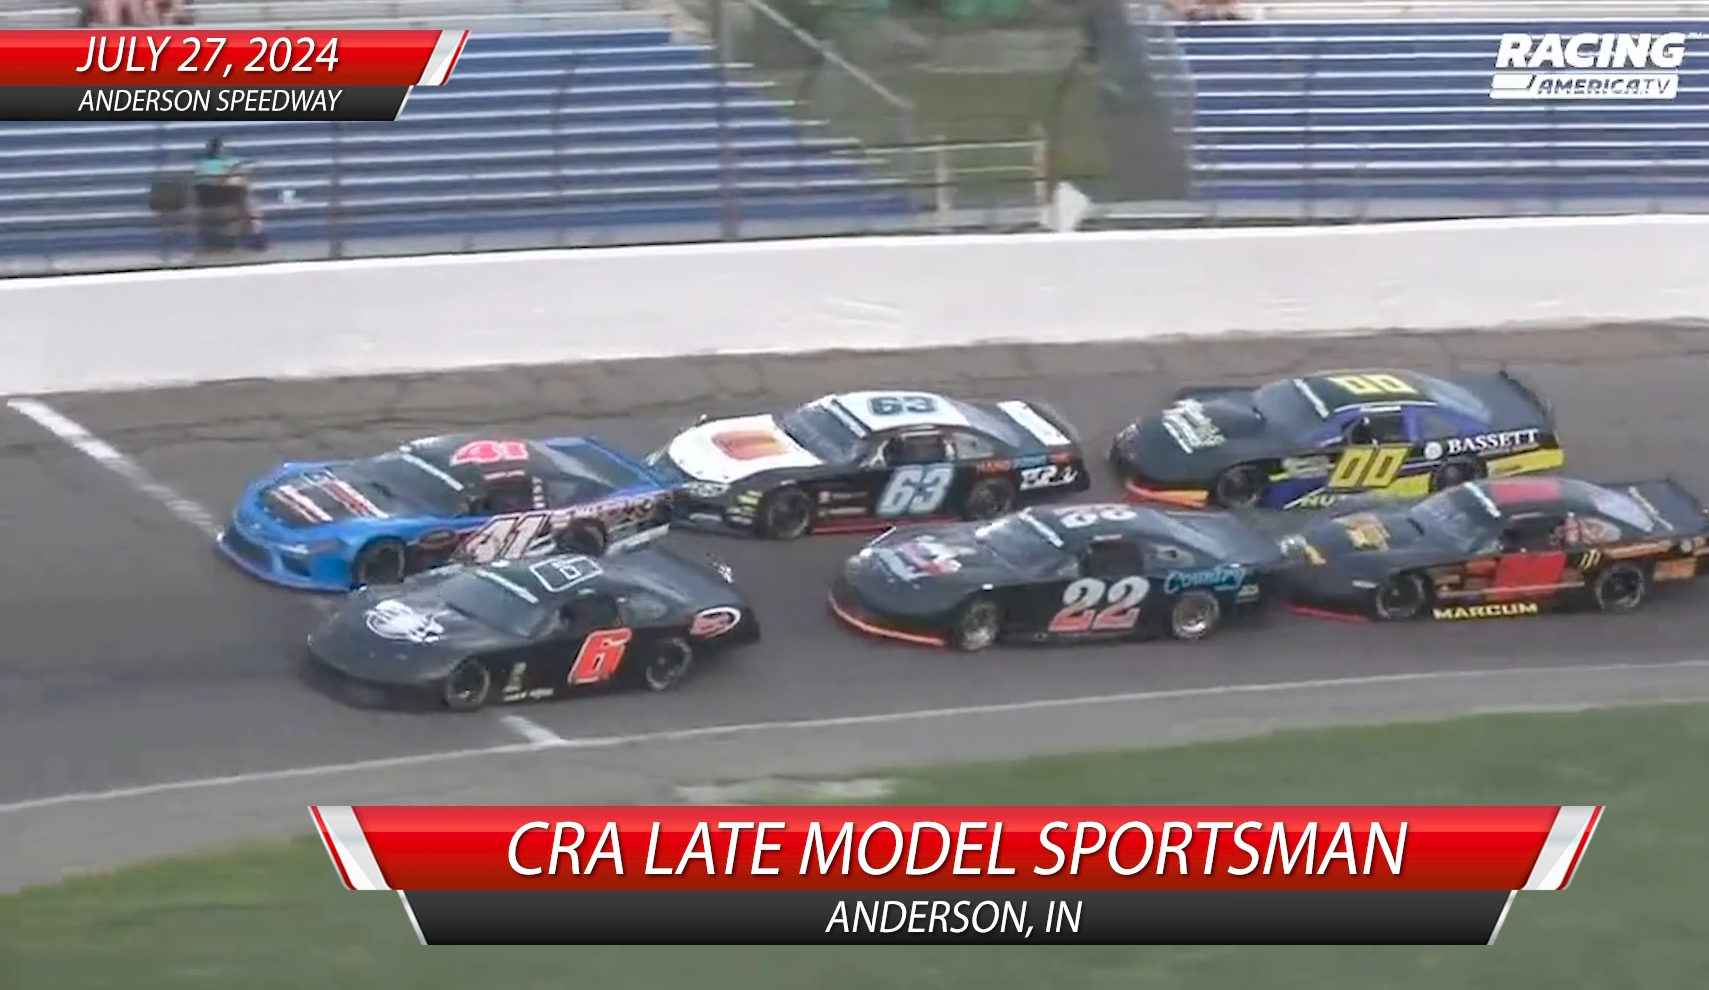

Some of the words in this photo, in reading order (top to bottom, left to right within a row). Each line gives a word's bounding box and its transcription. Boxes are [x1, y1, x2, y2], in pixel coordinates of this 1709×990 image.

[1447, 428, 1538, 454] BASSETT
[877, 464, 954, 515] 63
[1329, 447, 1408, 488] 00
[466, 512, 549, 563] 41
[1048, 576, 1149, 632] 22
[1433, 602, 1538, 619] MARCUM
[568, 628, 632, 685] 6
